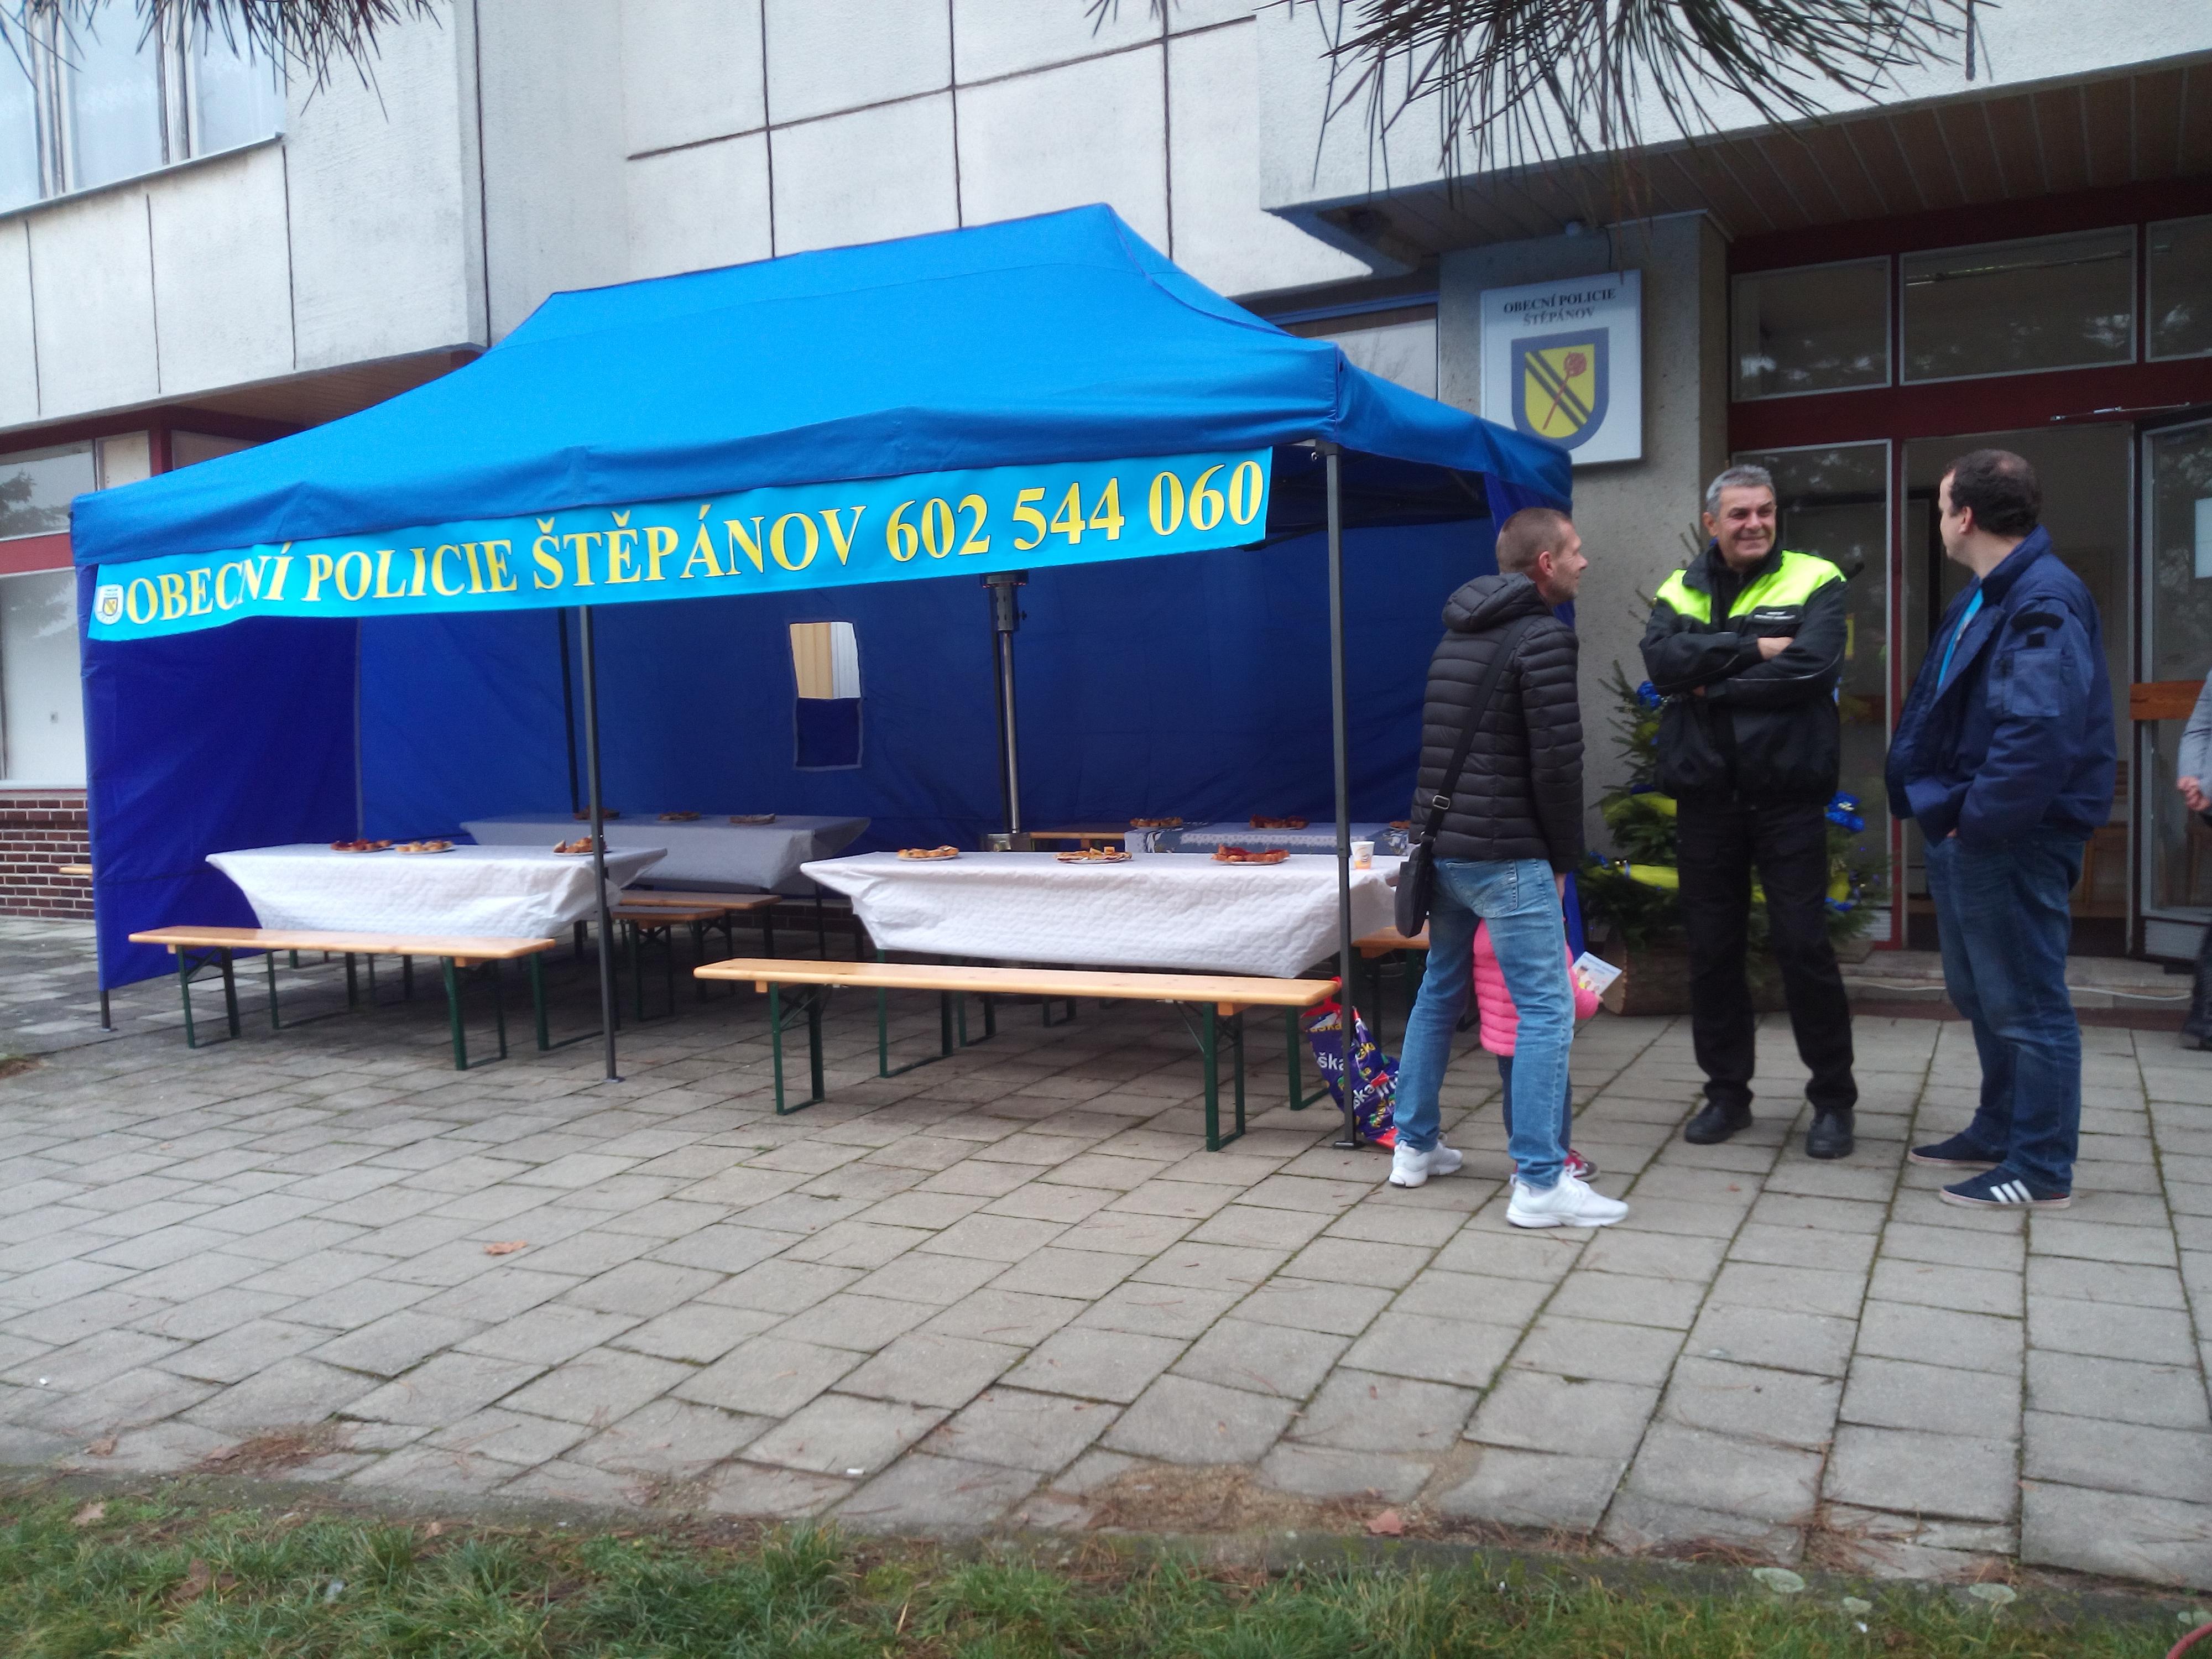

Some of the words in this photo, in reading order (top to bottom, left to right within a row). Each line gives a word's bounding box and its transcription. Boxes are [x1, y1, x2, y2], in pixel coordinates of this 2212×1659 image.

[1504, 293, 1556, 314] OBECNÍ
[1559, 288, 1616, 305] POLICIE
[126, 541, 294, 625] OBECNÍ
[301, 539, 518, 603] POLICIE
[531, 503, 867, 591] ŠTĚPÁNOV
[886, 493, 992, 562] 602
[1013, 477, 1125, 550] 544
[1148, 460, 1264, 536] 060
